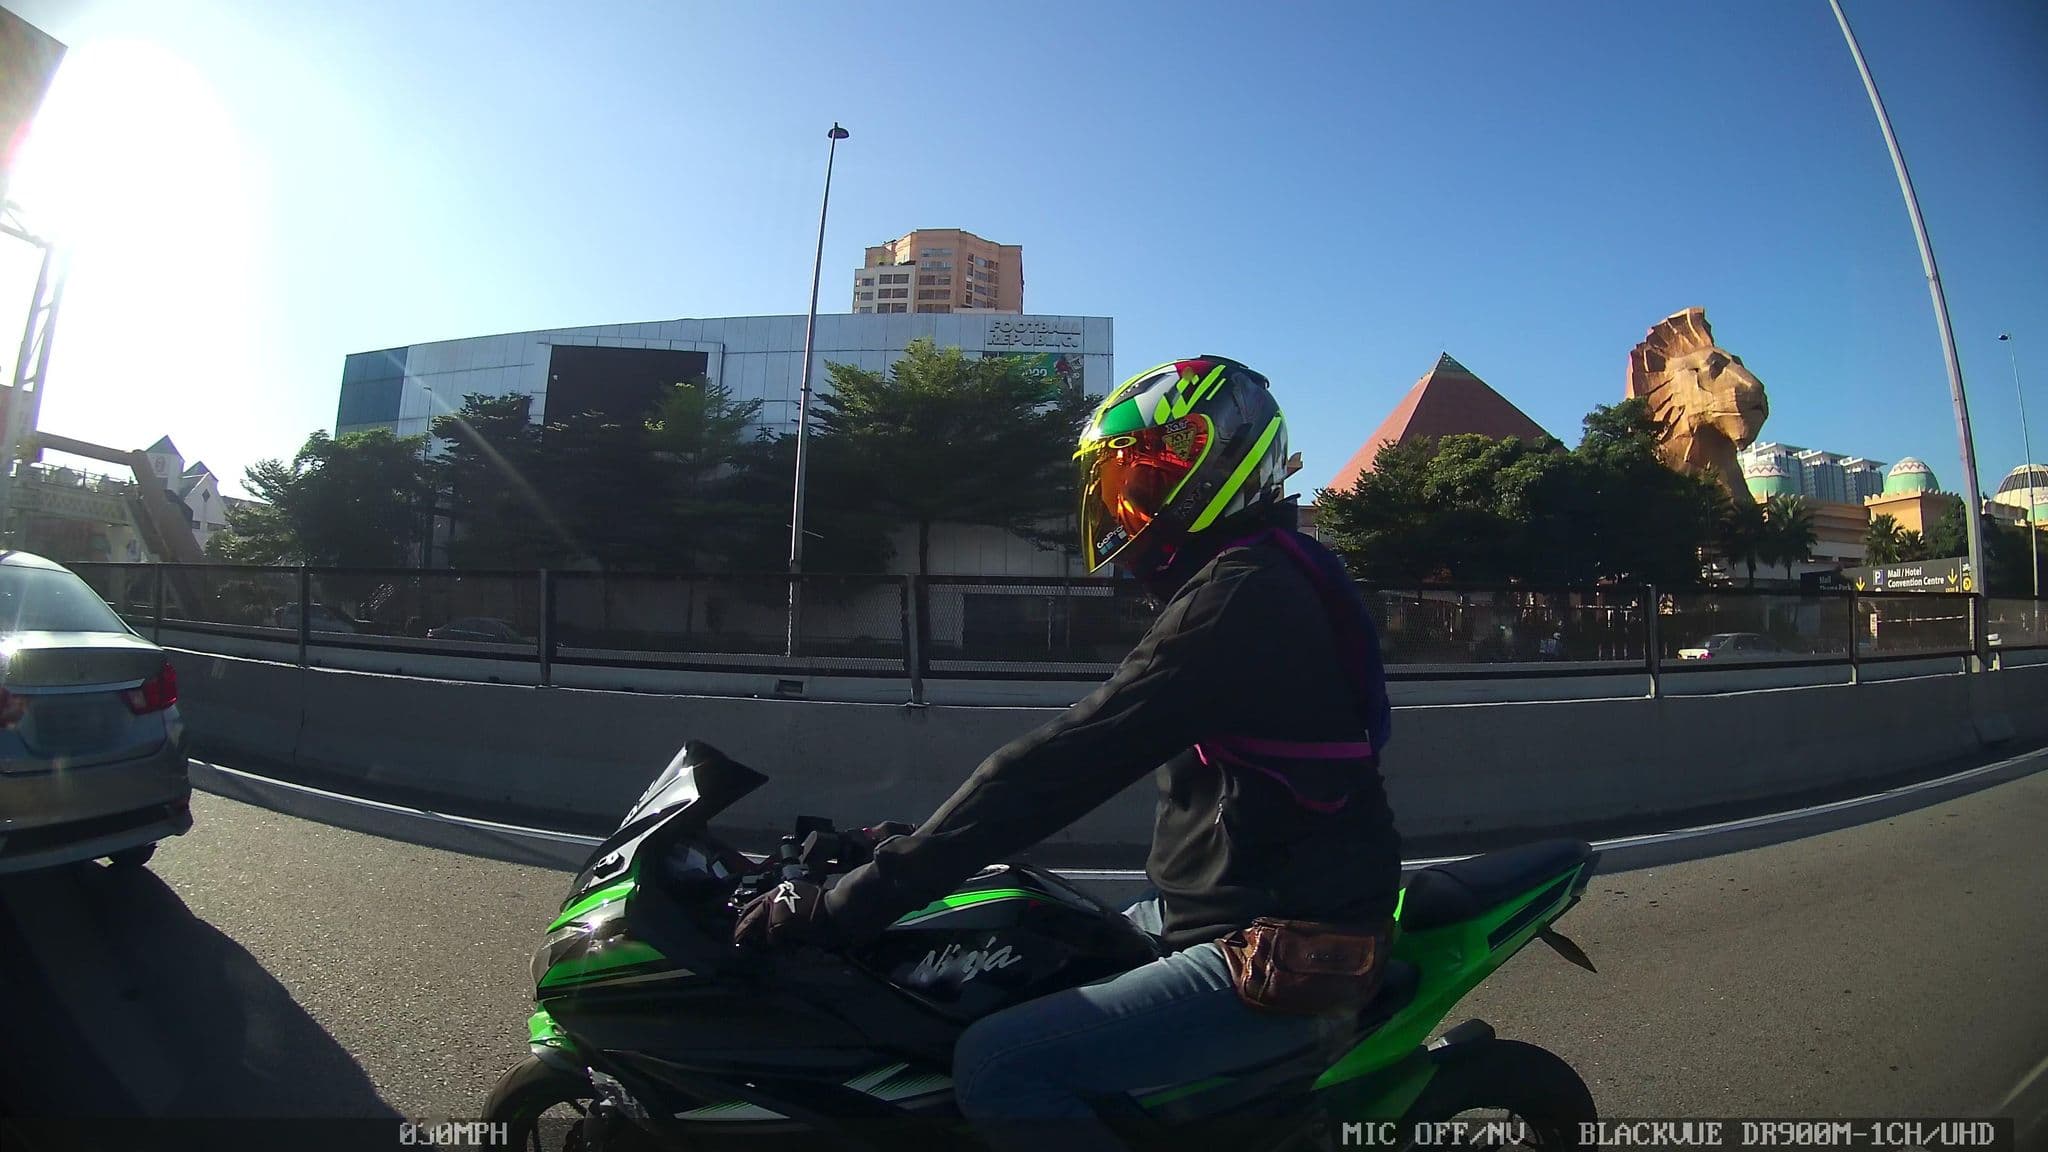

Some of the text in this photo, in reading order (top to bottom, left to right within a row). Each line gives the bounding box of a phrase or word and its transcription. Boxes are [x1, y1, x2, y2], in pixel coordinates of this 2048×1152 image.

[989, 320, 1080, 335] FOOTBALL
[987, 334, 1079, 348] REPUBLIC
[1887, 569, 1901, 579] Mall
[1905, 567, 1922, 577] Hotel
[1887, 576, 1945, 589] Convention Centre
